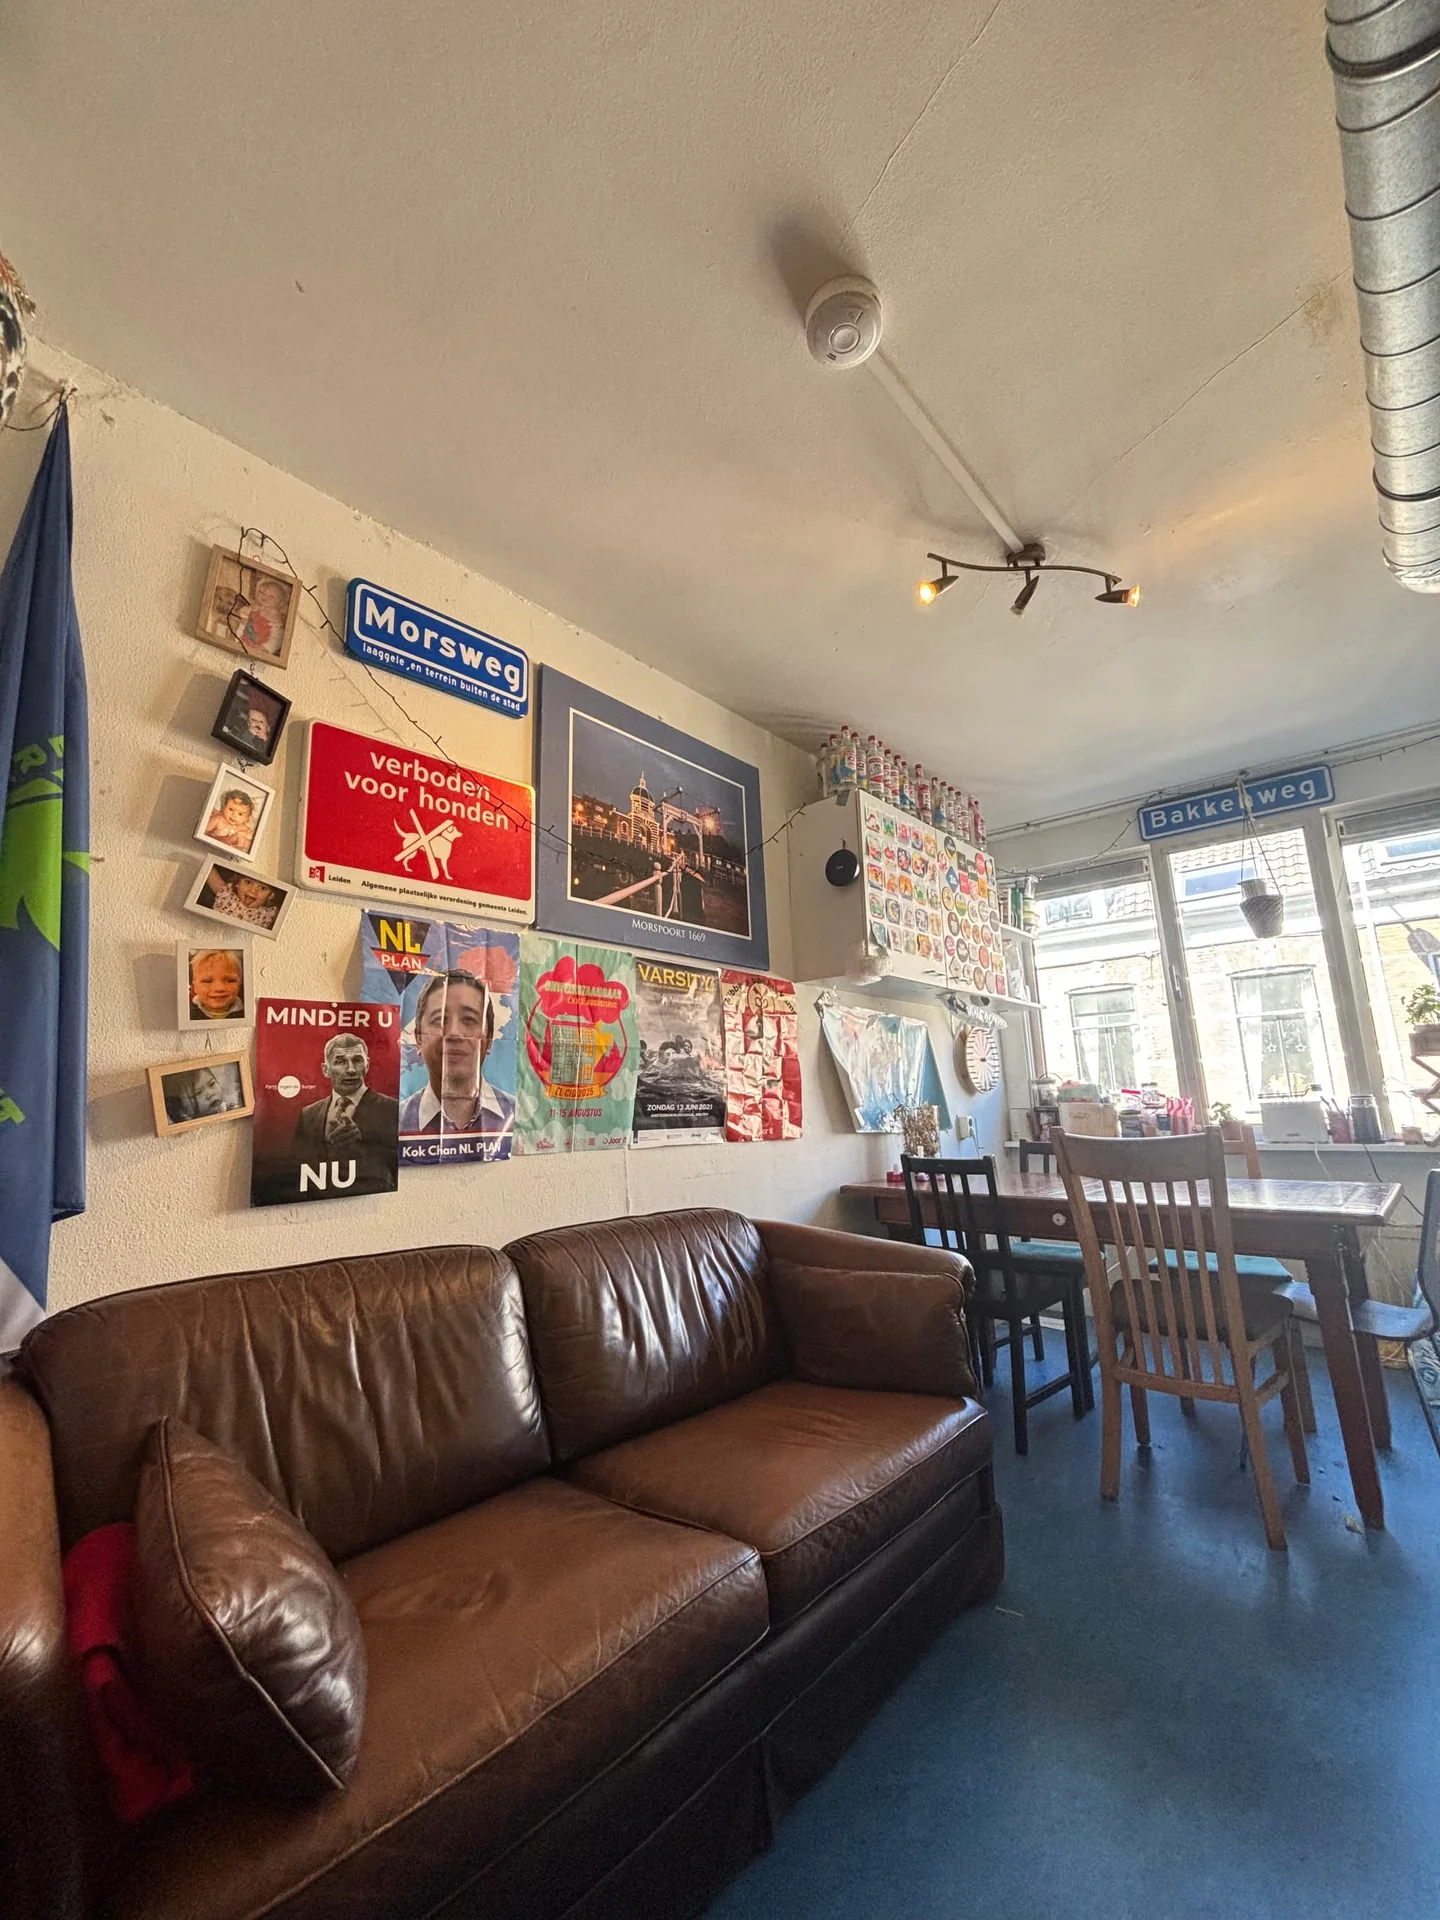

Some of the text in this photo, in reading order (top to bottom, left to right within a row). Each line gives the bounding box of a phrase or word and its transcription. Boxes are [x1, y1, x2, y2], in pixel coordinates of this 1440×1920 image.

[365, 597, 520, 693] Morsweg
[425, 666, 457, 686] terrein
[460, 680, 488, 698] buiten
[490, 693, 500, 703] de
[503, 698, 520, 711] stad
[370, 752, 490, 801] verboden
[344, 771, 509, 831] voor honden
[328, 875, 351, 884] Leiden
[361, 880, 397, 893] Algemene
[399, 887, 438, 900] plaatselijke
[439, 895, 477, 906] verordening
[478, 903, 507, 912] gemeente
[380, 919, 421, 954] NL
[632, 918, 706, 942] MORSPOORT 1669
[381, 953, 421, 970] PLAN
[638, 964, 714, 989] VARSITY
[266, 1006, 393, 1028] MINDER U
[402, 1141, 501, 1158] Kok Chan NL PLAN
[299, 1160, 356, 1193] NU
